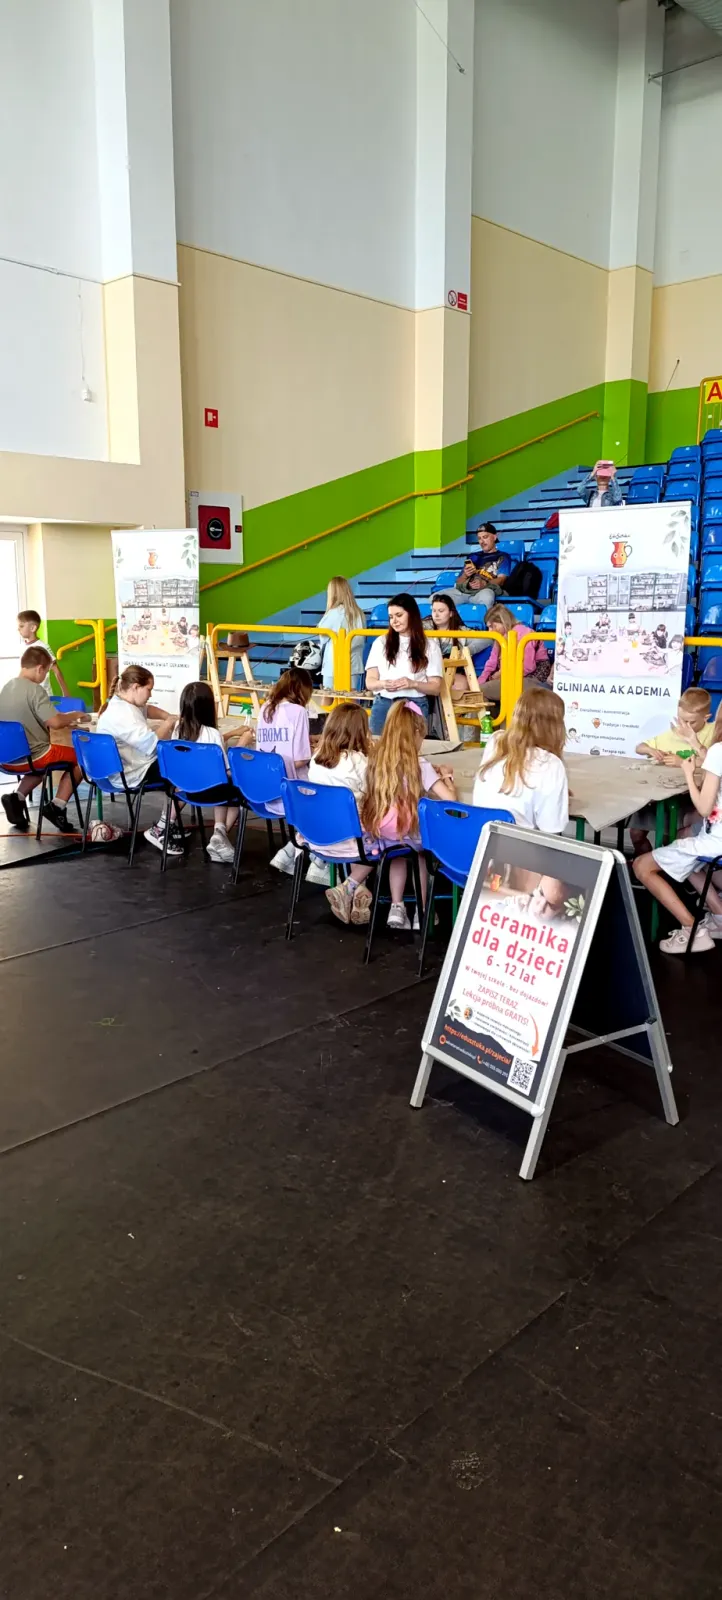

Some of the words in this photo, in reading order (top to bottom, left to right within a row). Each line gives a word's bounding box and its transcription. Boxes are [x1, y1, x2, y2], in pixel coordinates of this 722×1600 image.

[707, 382, 722, 402] A
[556, 682, 605, 694] GLINIANA
[610, 684, 671, 697] AKADEMIA
[479, 904, 569, 954] Ceramika
[471, 927, 500, 952] dla
[506, 940, 564, 979] dzieci
[470, 968, 487, 981] twojej
[488, 974, 505, 988] szkole
[509, 984, 519, 995] bez
[520, 989, 549, 1007] dojazdów!
[486, 955, 494, 966] 6
[504, 962, 517, 977] 12
[519, 968, 537, 986] lat
[462, 988, 481, 1004] Lekcja
[481, 997, 504, 1014] próbna
[504, 1009, 530, 1026] GRATIS!
[477, 984, 500, 1001] ZAPISZ
[500, 995, 519, 1010] TERAZ
